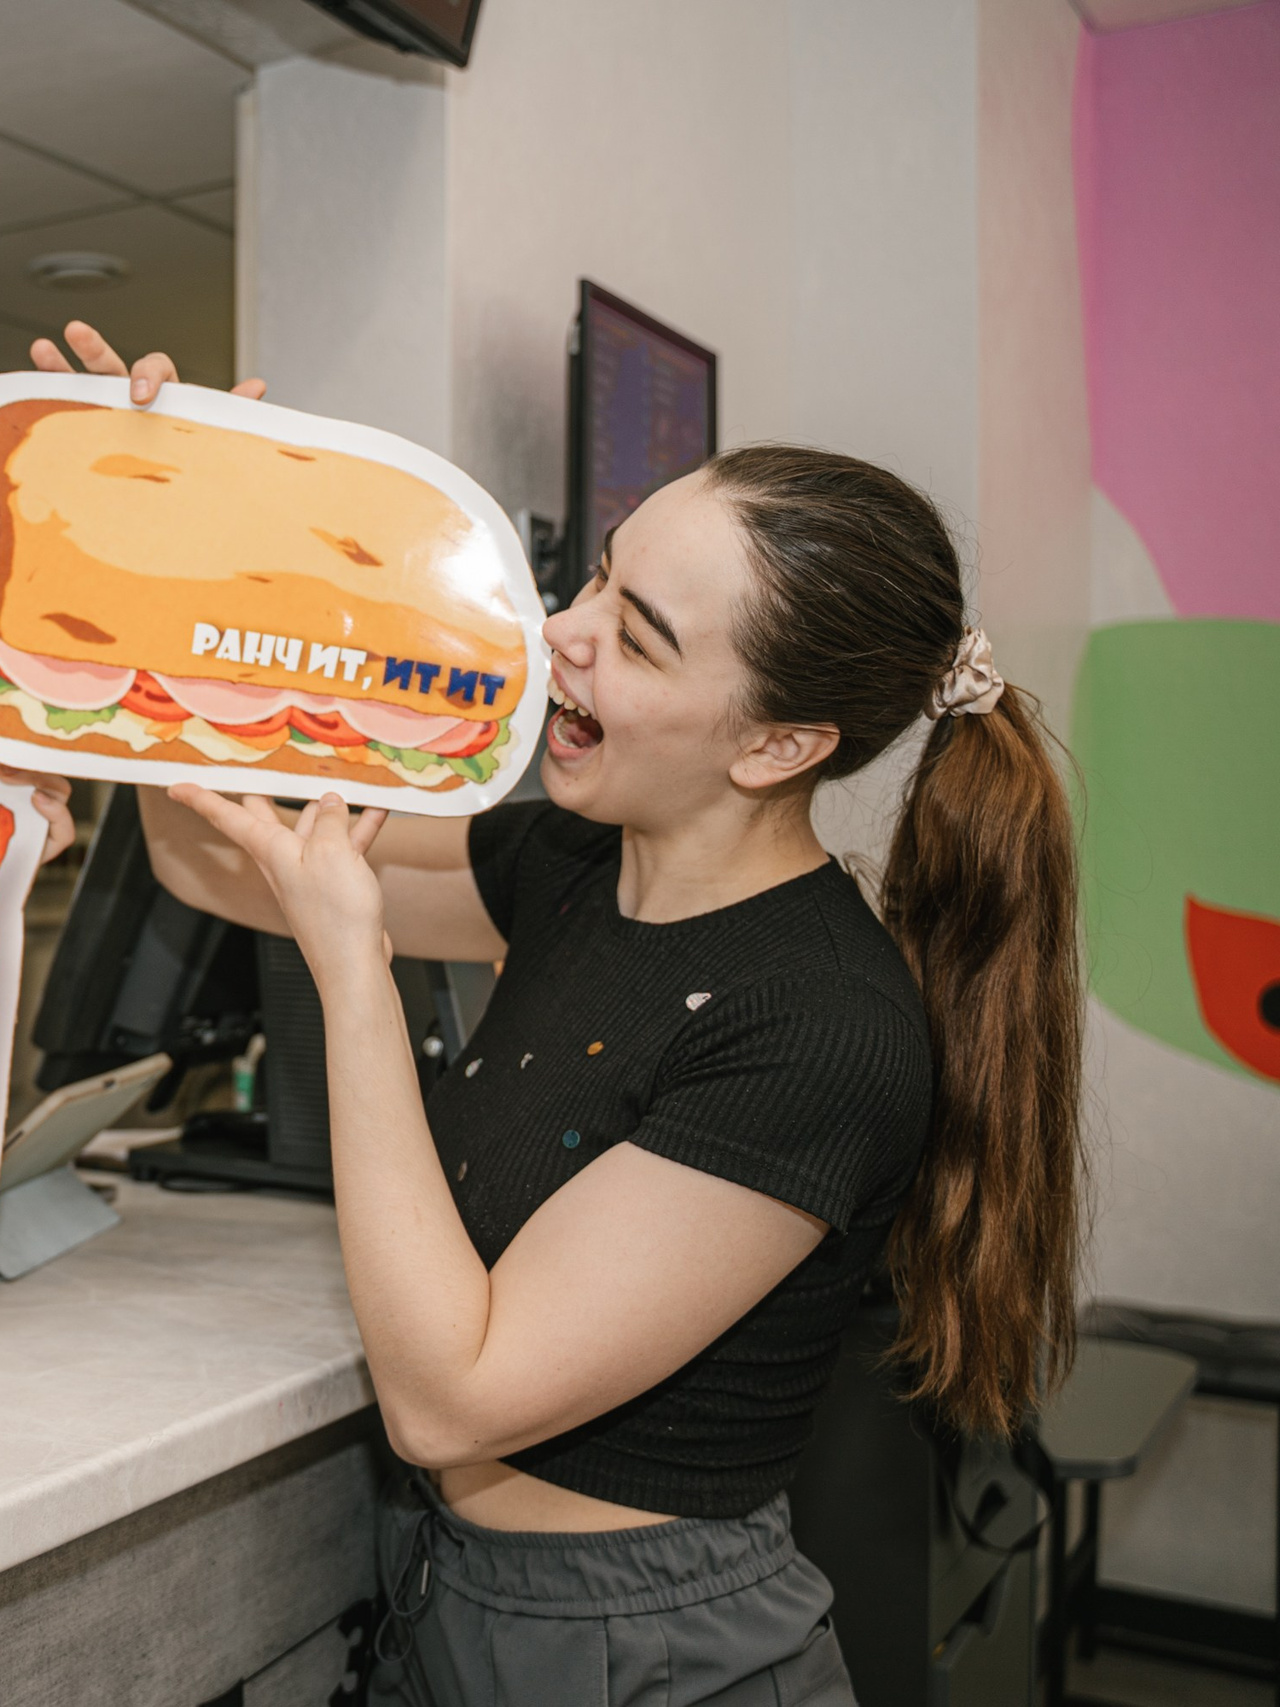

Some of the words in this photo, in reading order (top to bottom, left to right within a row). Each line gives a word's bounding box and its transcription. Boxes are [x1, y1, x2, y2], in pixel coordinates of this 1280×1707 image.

[191, 622, 304, 672] РАНЧ
[307, 642, 373, 691] ИТ,
[382, 656, 441, 695] ИТ
[446, 667, 506, 706] ИТ
